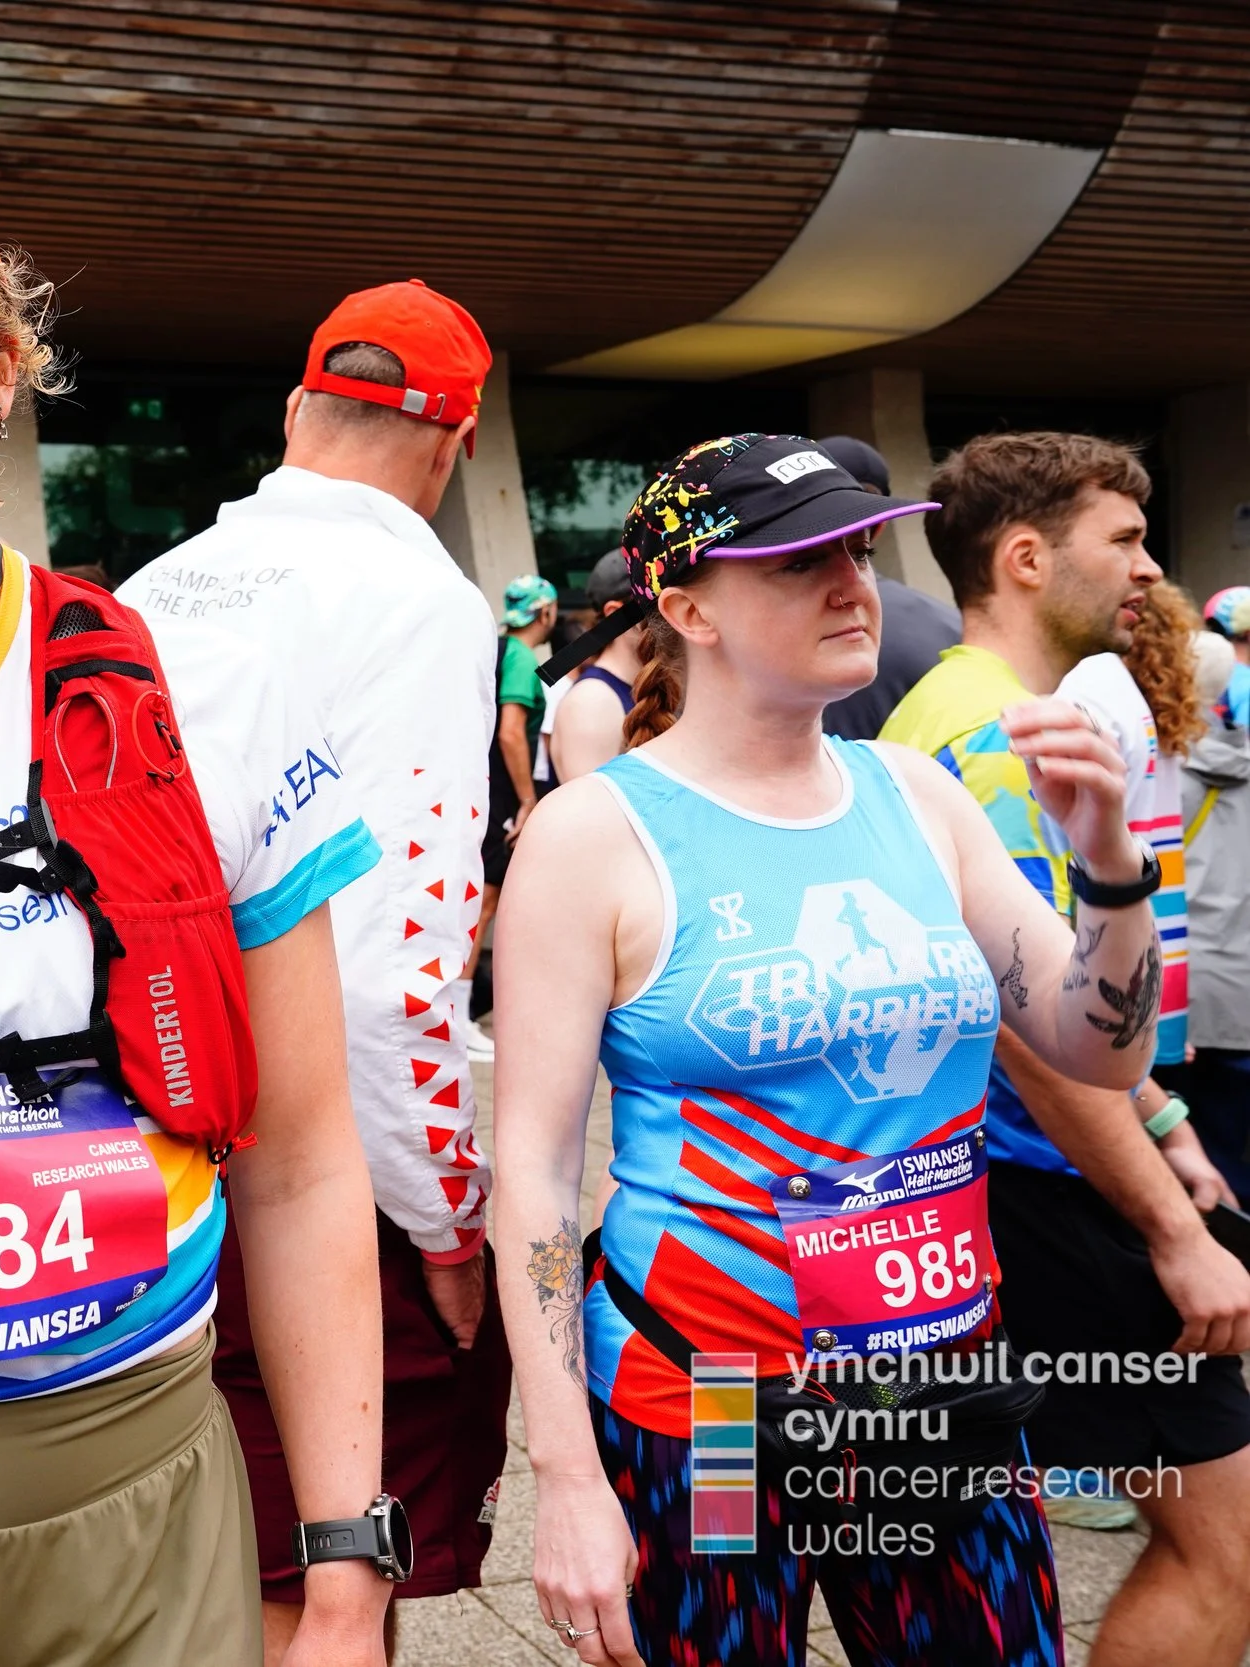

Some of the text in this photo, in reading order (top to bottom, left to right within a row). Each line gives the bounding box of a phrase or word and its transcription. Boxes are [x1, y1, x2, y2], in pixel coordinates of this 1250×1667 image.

[254, 567, 295, 586] OF
[144, 588, 258, 619] THE RODS
[748, 986, 995, 1057] HARRIERS
[21, 1121, 64, 1133] ABERTAWE
[89, 1140, 142, 1157] CANCER
[902, 1141, 971, 1175] SWANSEA
[32, 1156, 150, 1188] RESEARCH WALES
[795, 1209, 942, 1259] MICHELLE
[875, 1230, 977, 1309] 985
[866, 1299, 987, 1350] #RUNSWANSEA
